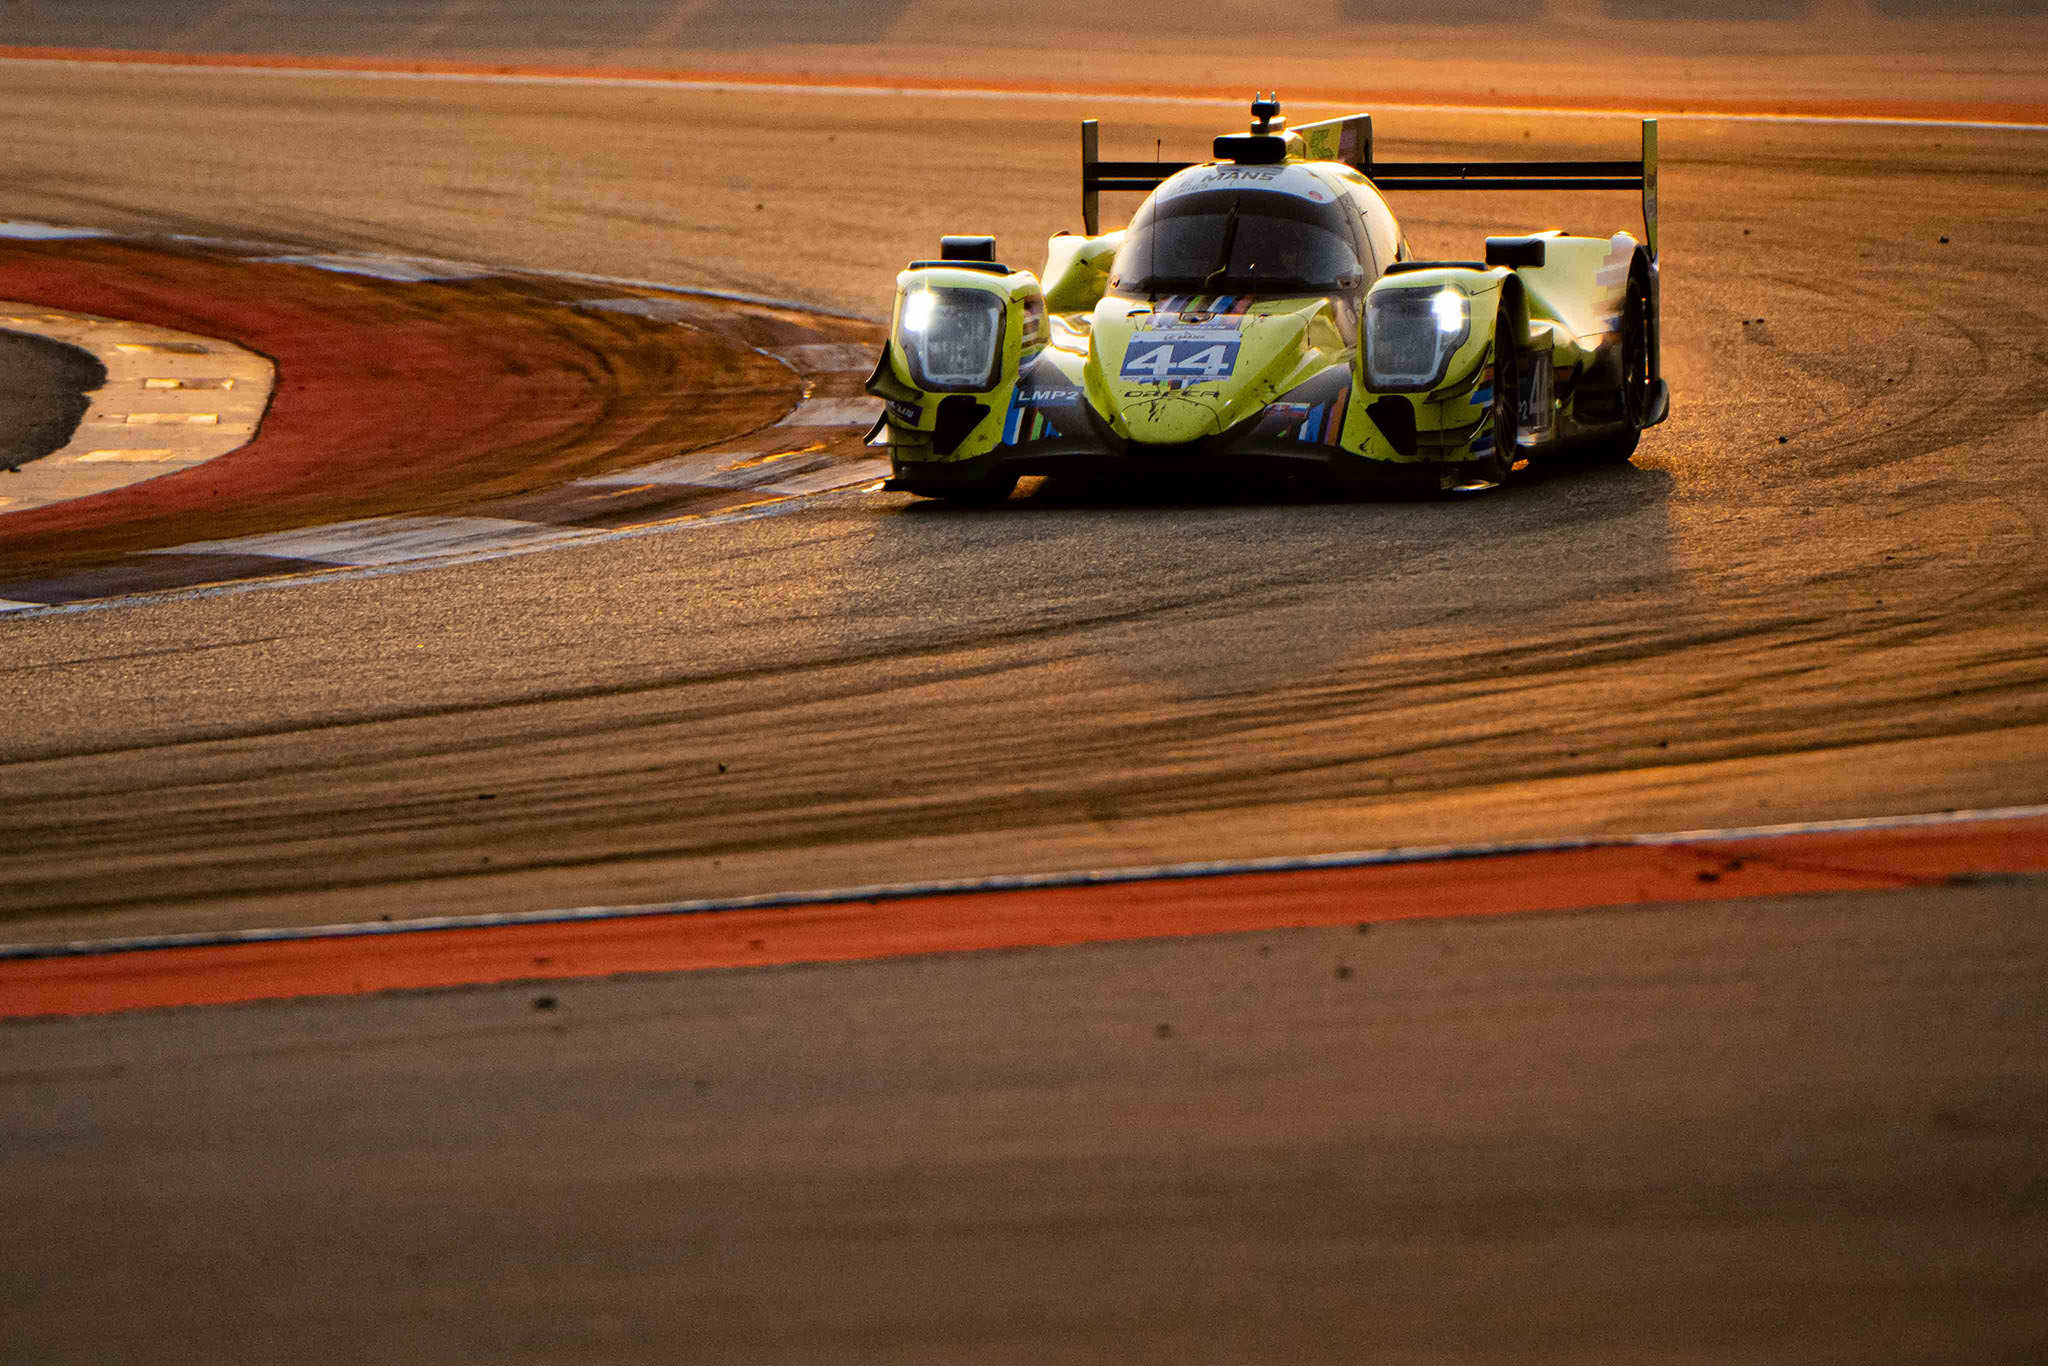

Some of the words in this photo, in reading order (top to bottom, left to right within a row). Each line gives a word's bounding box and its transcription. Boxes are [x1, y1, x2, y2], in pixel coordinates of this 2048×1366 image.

[1202, 171, 1274, 182] MANS
[1126, 344, 1229, 375] 44
[1018, 390, 1080, 401] LMP2
[1124, 391, 1220, 400] ORECA
